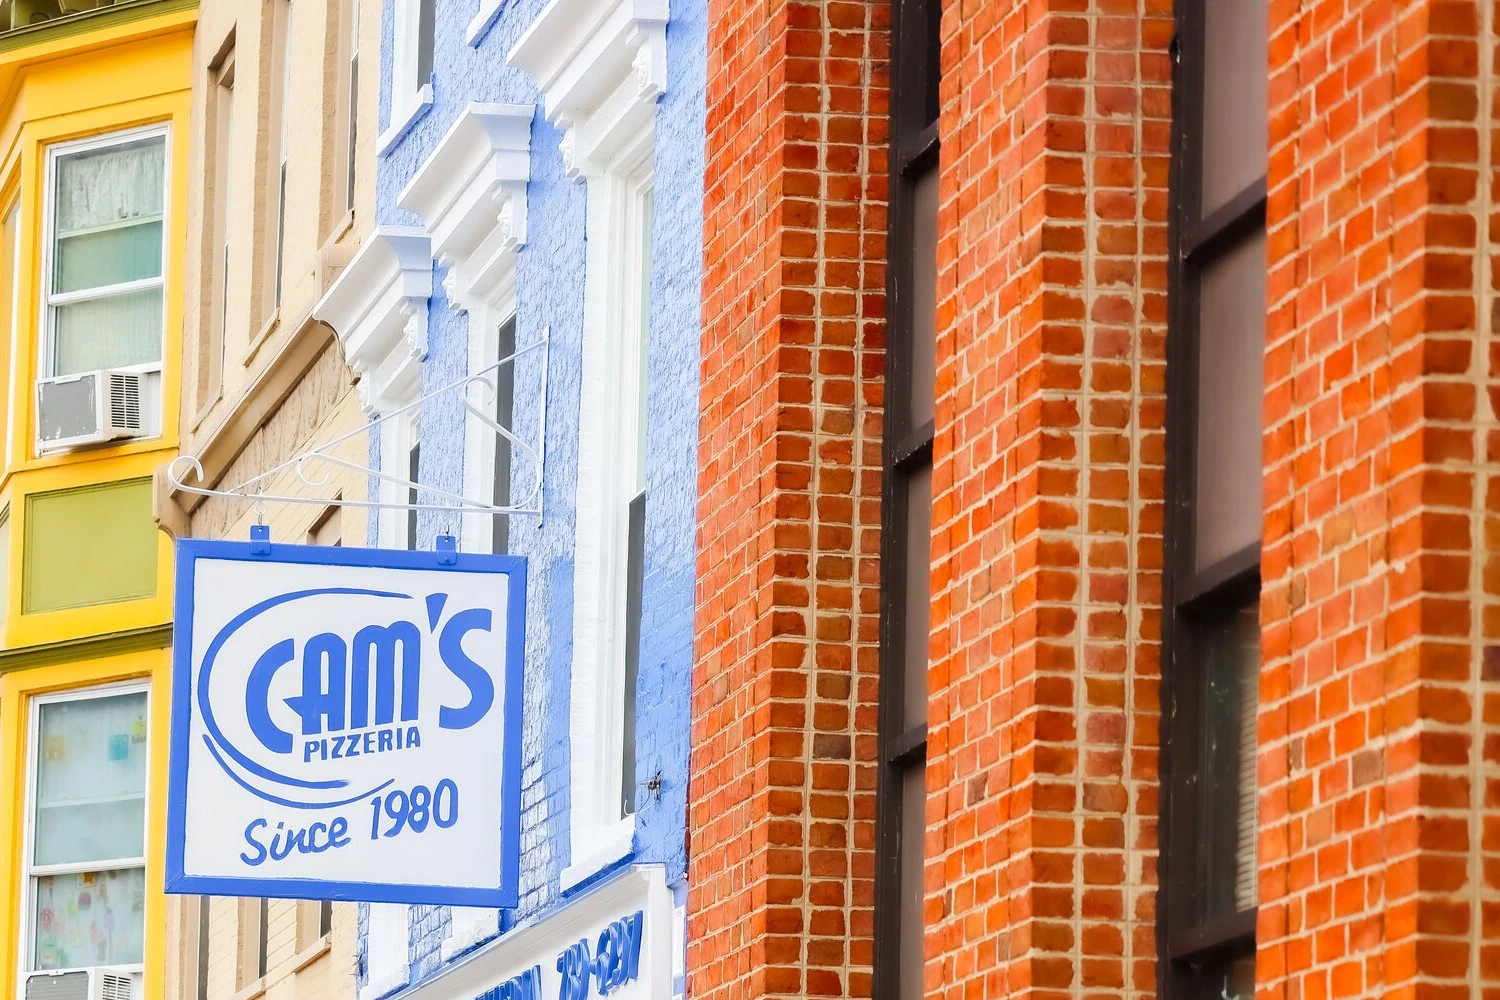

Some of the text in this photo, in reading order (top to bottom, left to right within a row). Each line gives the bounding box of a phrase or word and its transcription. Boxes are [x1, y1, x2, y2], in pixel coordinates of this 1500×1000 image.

[246, 593, 495, 754] CAM'S
[303, 725, 421, 763] PIZZERIA
[239, 778, 459, 867] Since 1980
